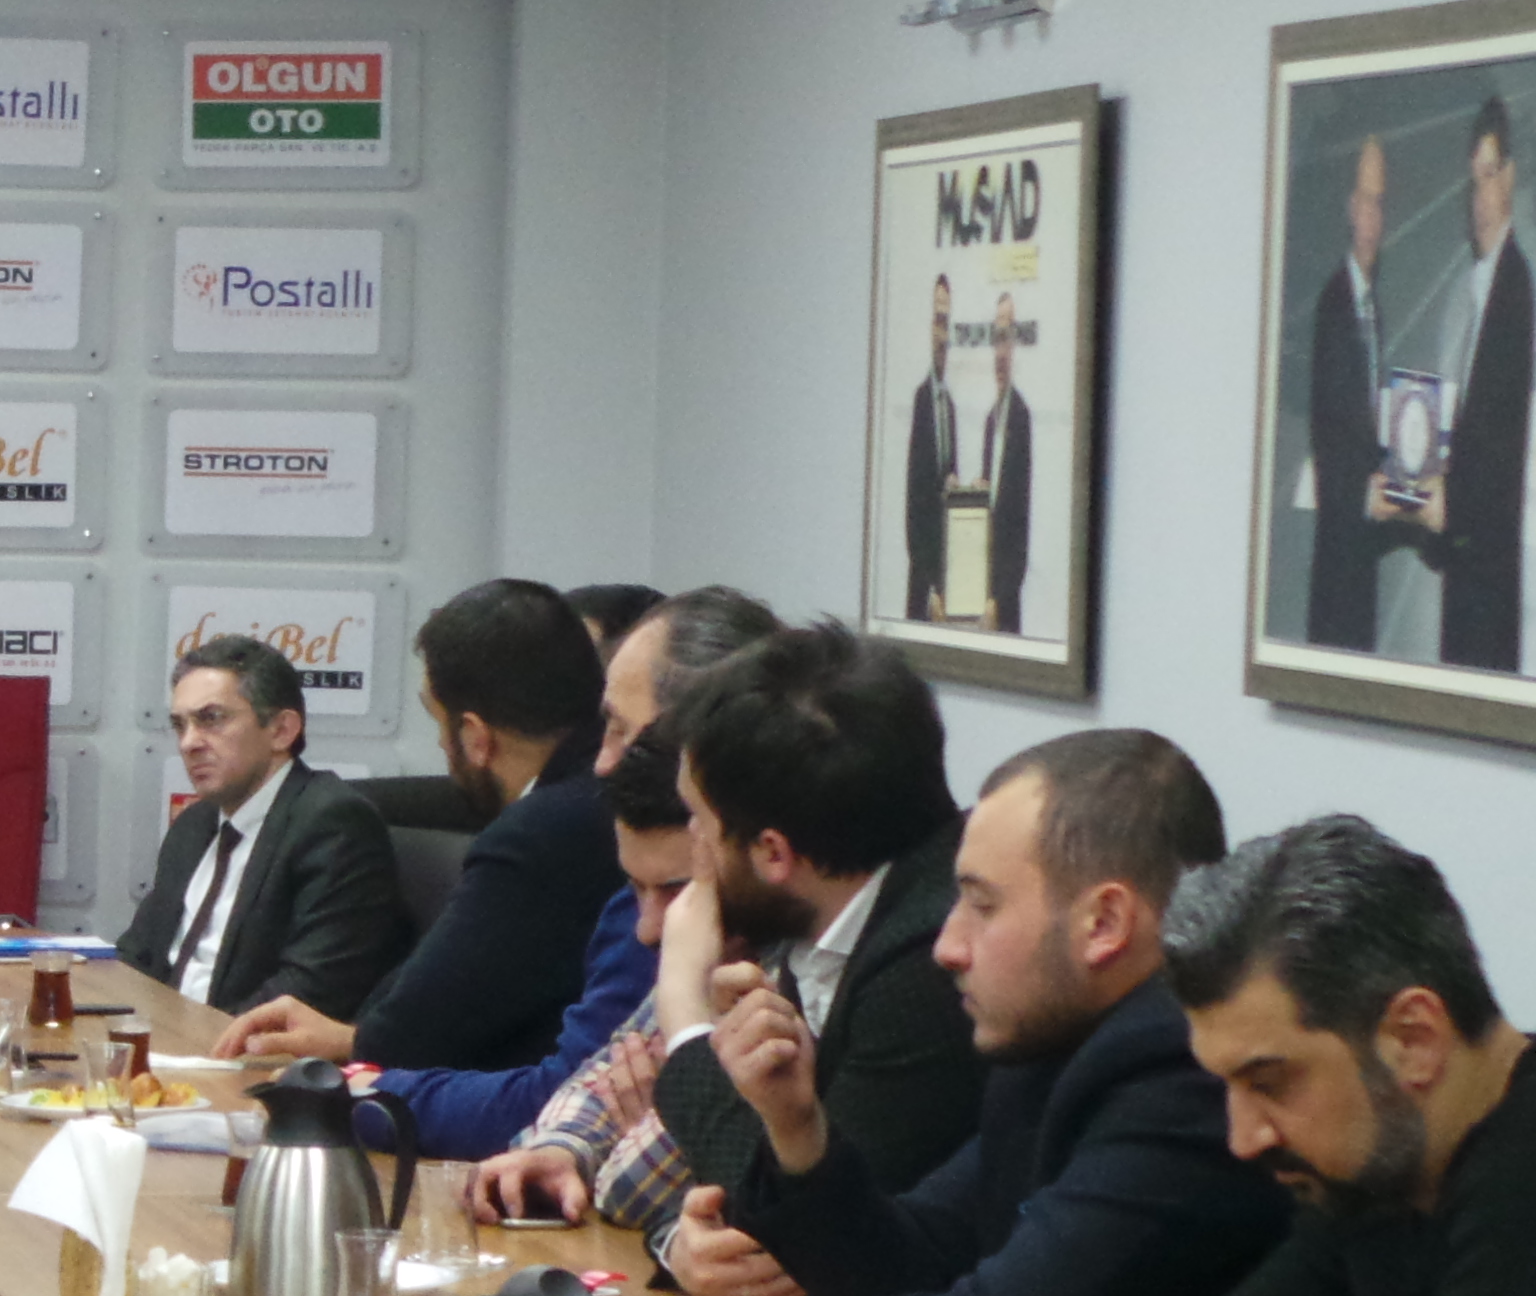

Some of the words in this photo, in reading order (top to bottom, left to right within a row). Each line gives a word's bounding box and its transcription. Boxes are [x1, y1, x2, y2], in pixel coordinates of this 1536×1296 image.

[208, 61, 366, 93] OLGUN
[250, 108, 323, 133] OTO
[184, 454, 327, 471] STROTON
